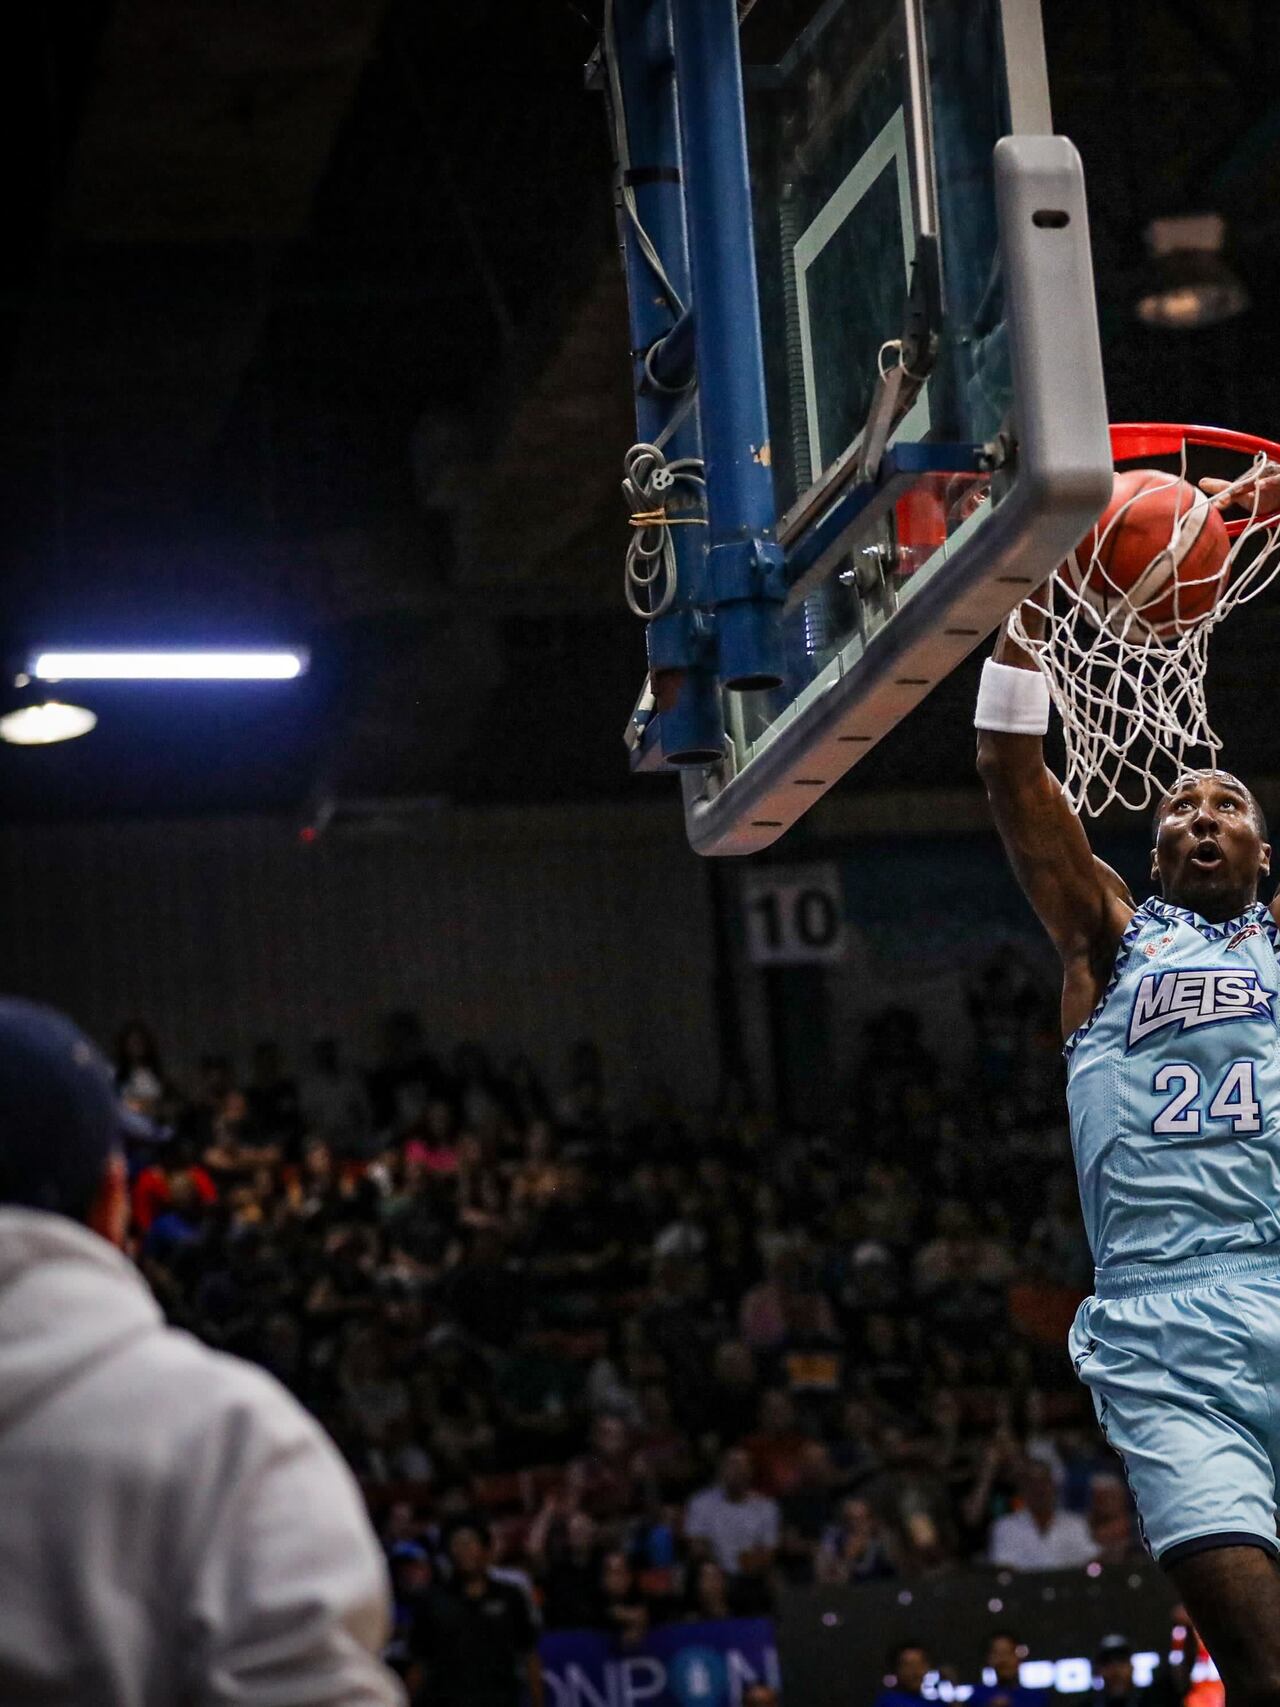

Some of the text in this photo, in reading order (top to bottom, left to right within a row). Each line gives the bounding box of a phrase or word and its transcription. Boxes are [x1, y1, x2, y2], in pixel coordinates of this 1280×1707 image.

[756, 888, 836, 947] 10
[1126, 967, 1262, 1050] METS
[1151, 1060, 1263, 1136] 24
